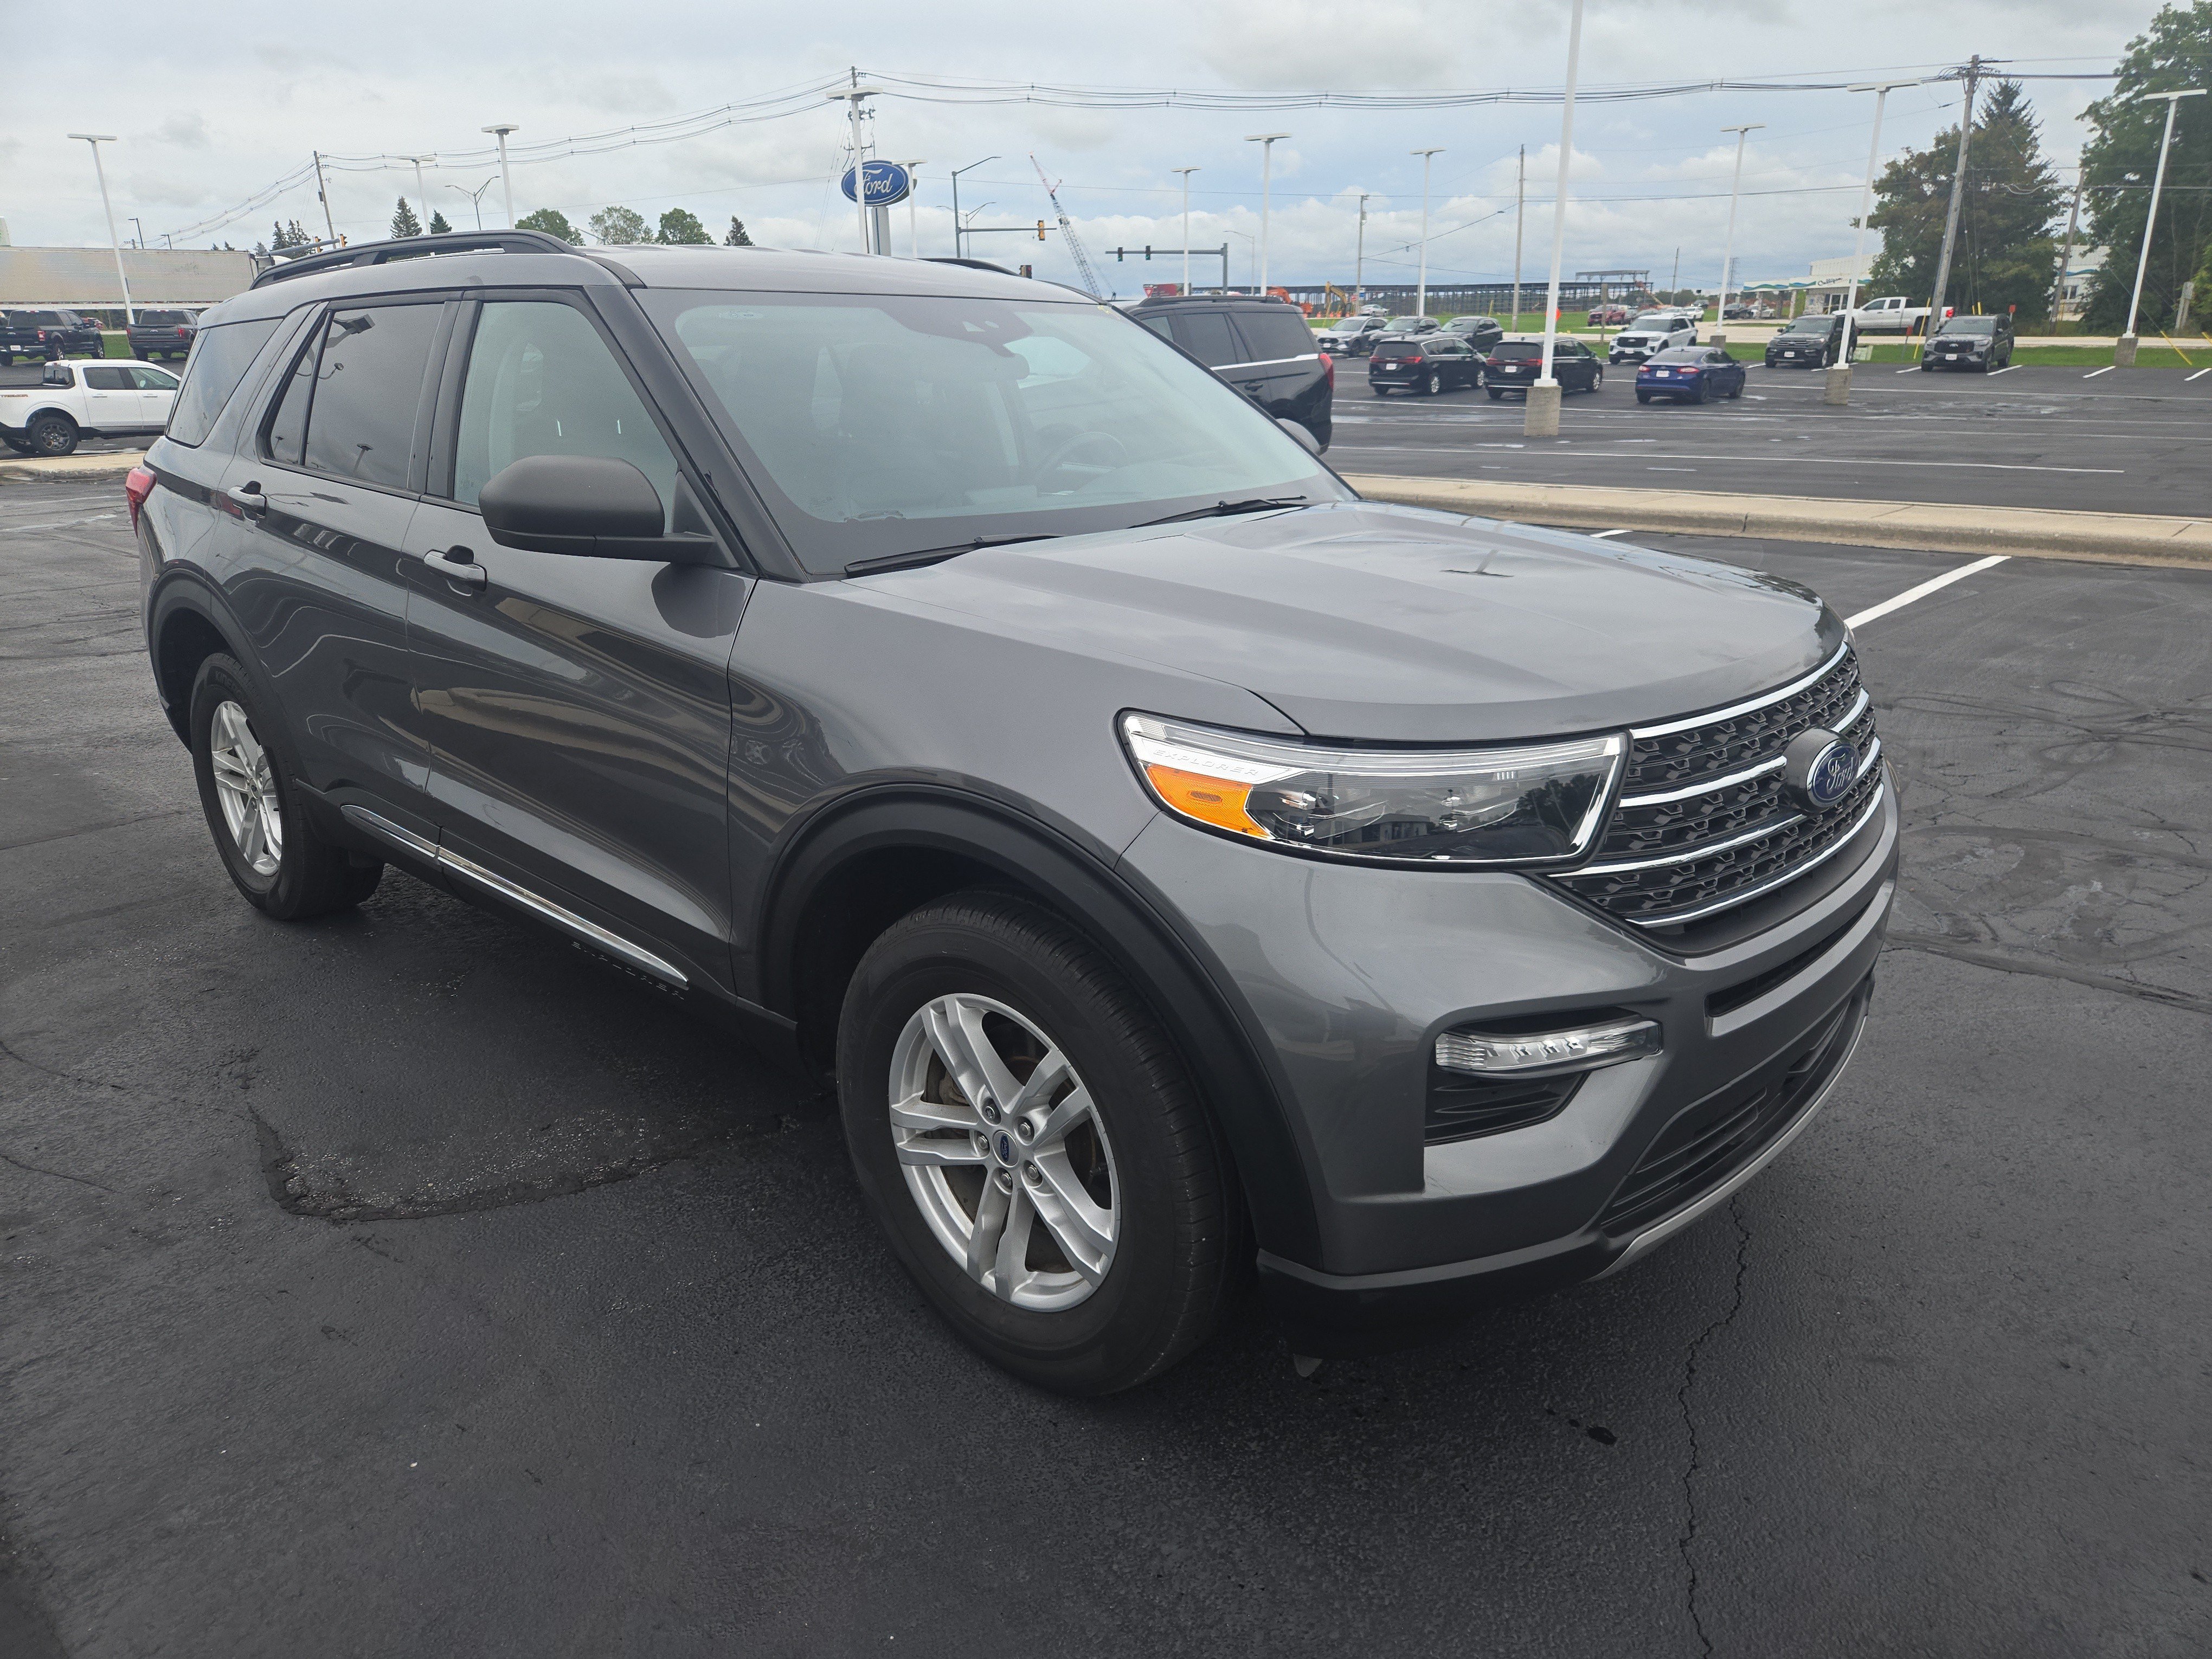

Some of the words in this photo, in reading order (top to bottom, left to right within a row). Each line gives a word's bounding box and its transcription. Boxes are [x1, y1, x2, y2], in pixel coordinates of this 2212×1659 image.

[854, 169, 893, 196] Ford
[1153, 749, 1259, 776] EXPLORER
[1826, 752, 1855, 795] Ford
